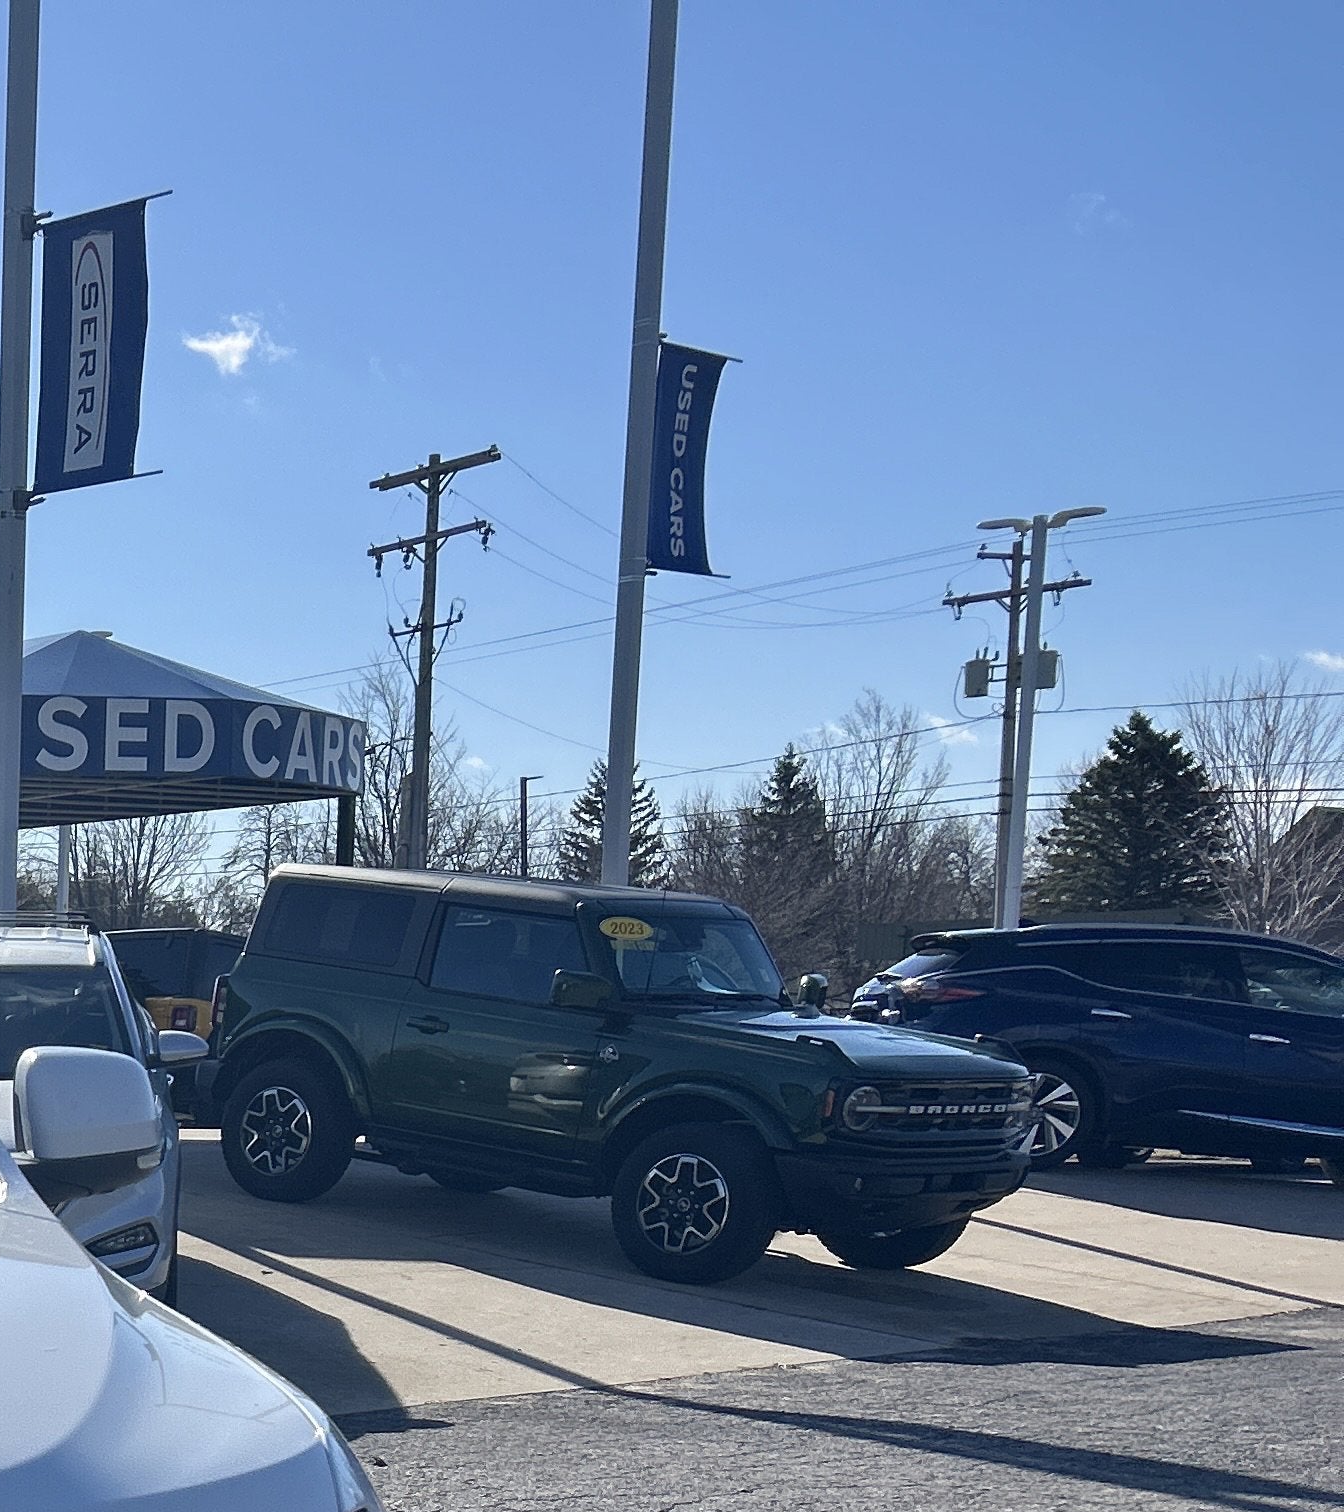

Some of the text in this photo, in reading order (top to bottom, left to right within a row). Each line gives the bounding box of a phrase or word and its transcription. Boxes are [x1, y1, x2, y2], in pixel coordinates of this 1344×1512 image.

[73, 281, 99, 454] SERRA
[669, 364, 698, 558] USED CARS
[242, 704, 363, 791] CARS
[610, 922, 644, 935] 2023
[909, 1104, 1008, 1114] BRONCO
